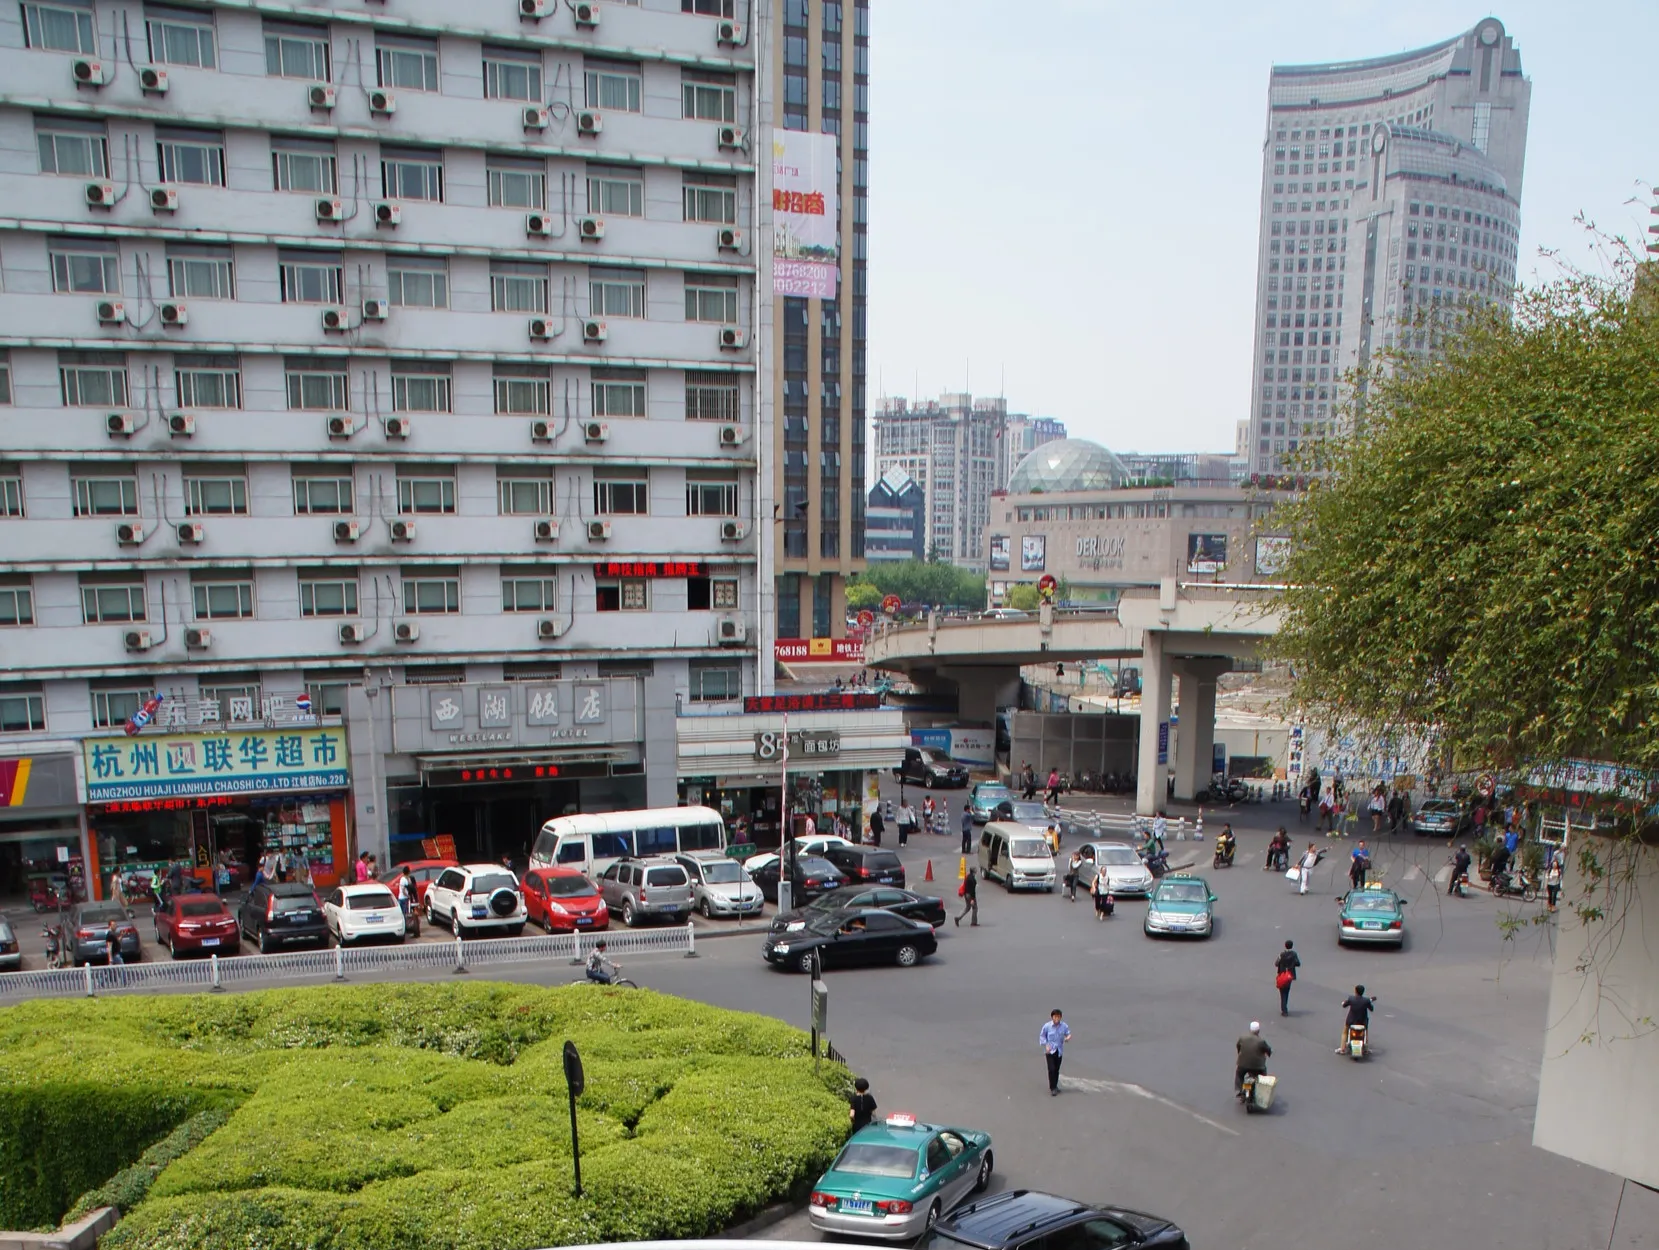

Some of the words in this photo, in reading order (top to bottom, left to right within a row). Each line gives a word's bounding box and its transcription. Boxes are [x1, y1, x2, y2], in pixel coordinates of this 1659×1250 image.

[774, 645, 808, 657] 768188
[164, 695, 287, 726] 东声网吧
[435, 688, 601, 723] 西湖饭店
[449, 731, 512, 744] WESTLAKE
[552, 728, 589, 738] HOTEL
[804, 738, 840, 754] 面包坊
[92, 743, 159, 778] 杭州
[203, 733, 339, 772] 联华超市
[89, 786, 143, 800] HANGZHOU
[144, 784, 172, 797] HUAJI
[173, 782, 214, 795] LIANHUA
[214, 779, 255, 792] CHAOSHI
